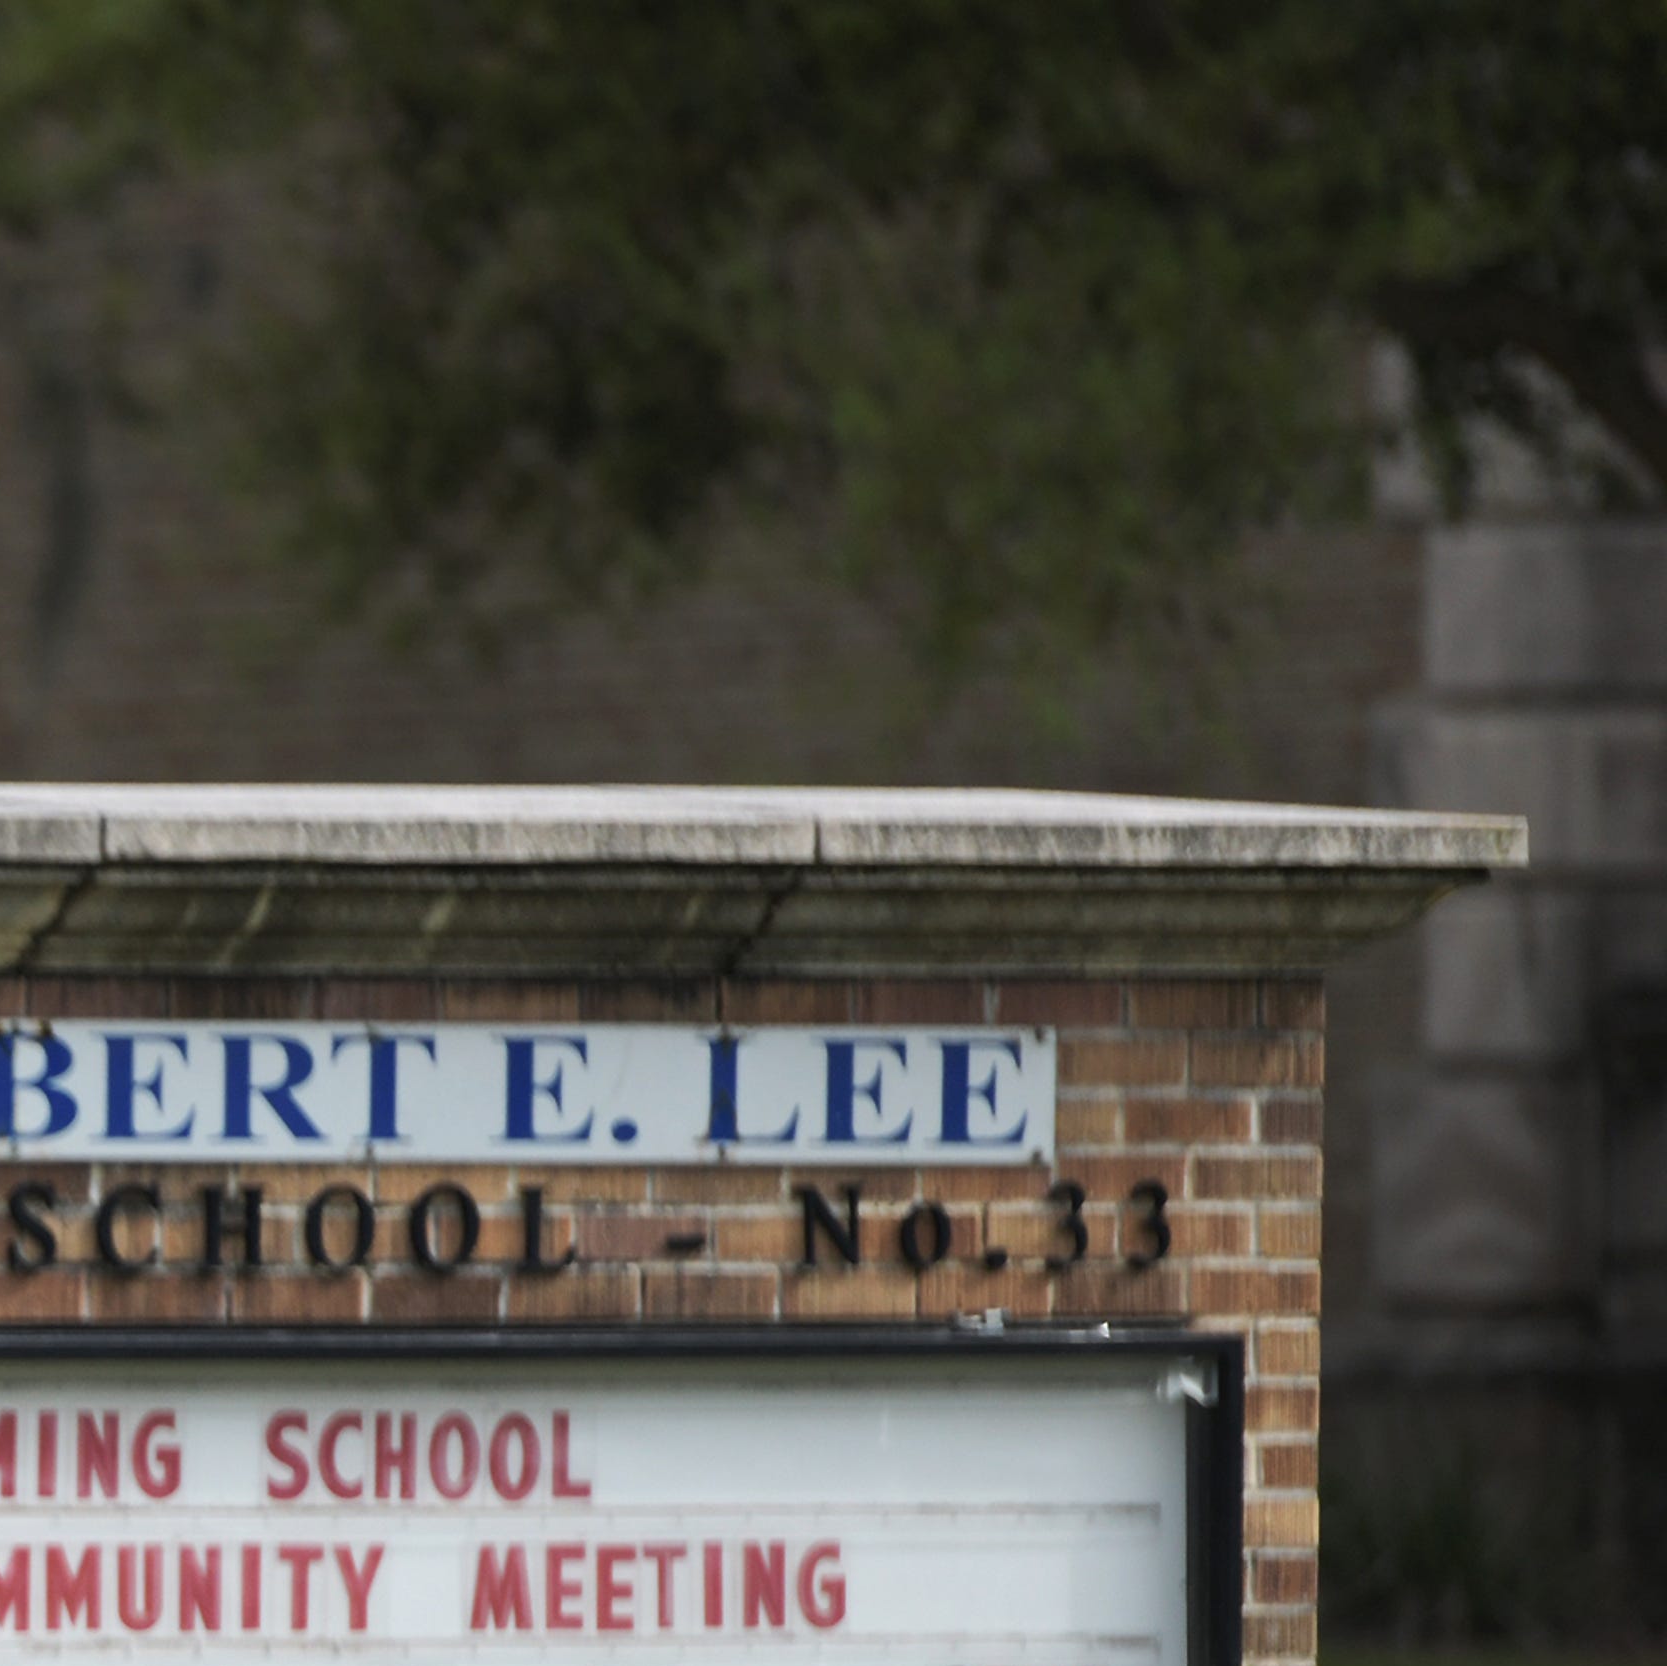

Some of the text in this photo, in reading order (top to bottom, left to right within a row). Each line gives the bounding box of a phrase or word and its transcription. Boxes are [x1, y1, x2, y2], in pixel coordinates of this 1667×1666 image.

[501, 1036, 640, 1145] E.
[706, 1036, 1027, 1145] LEE
[5, 1181, 578, 1274] SCHOOL
[265, 1412, 593, 1502] SCHOOL
[470, 1542, 848, 1632] MEETING
